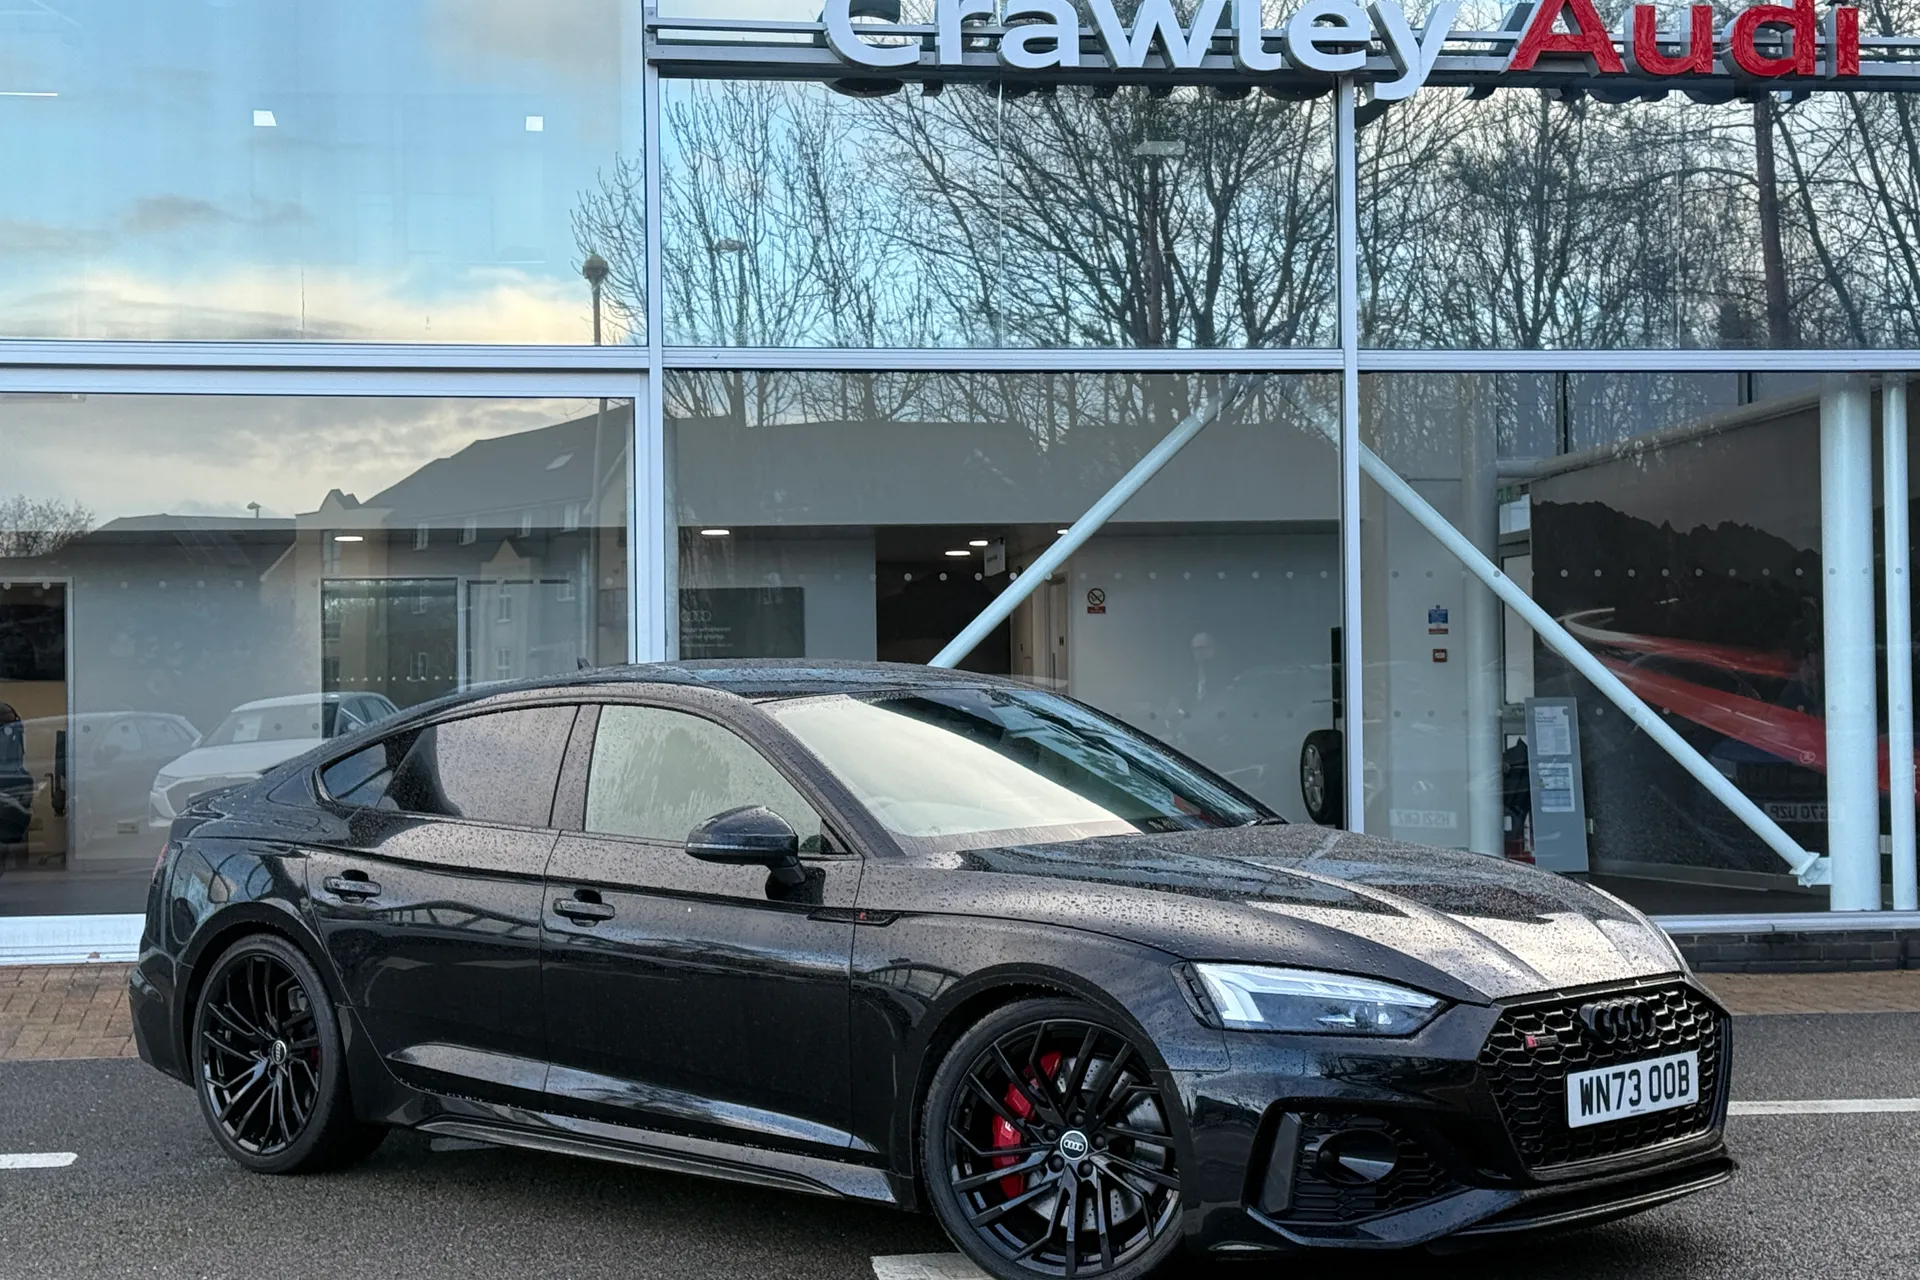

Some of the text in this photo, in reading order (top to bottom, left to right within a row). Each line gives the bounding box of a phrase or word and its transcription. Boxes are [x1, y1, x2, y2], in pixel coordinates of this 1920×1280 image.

[822, 0, 1860, 100] Crawley Audi
[1579, 1069, 1642, 1117] WN73
